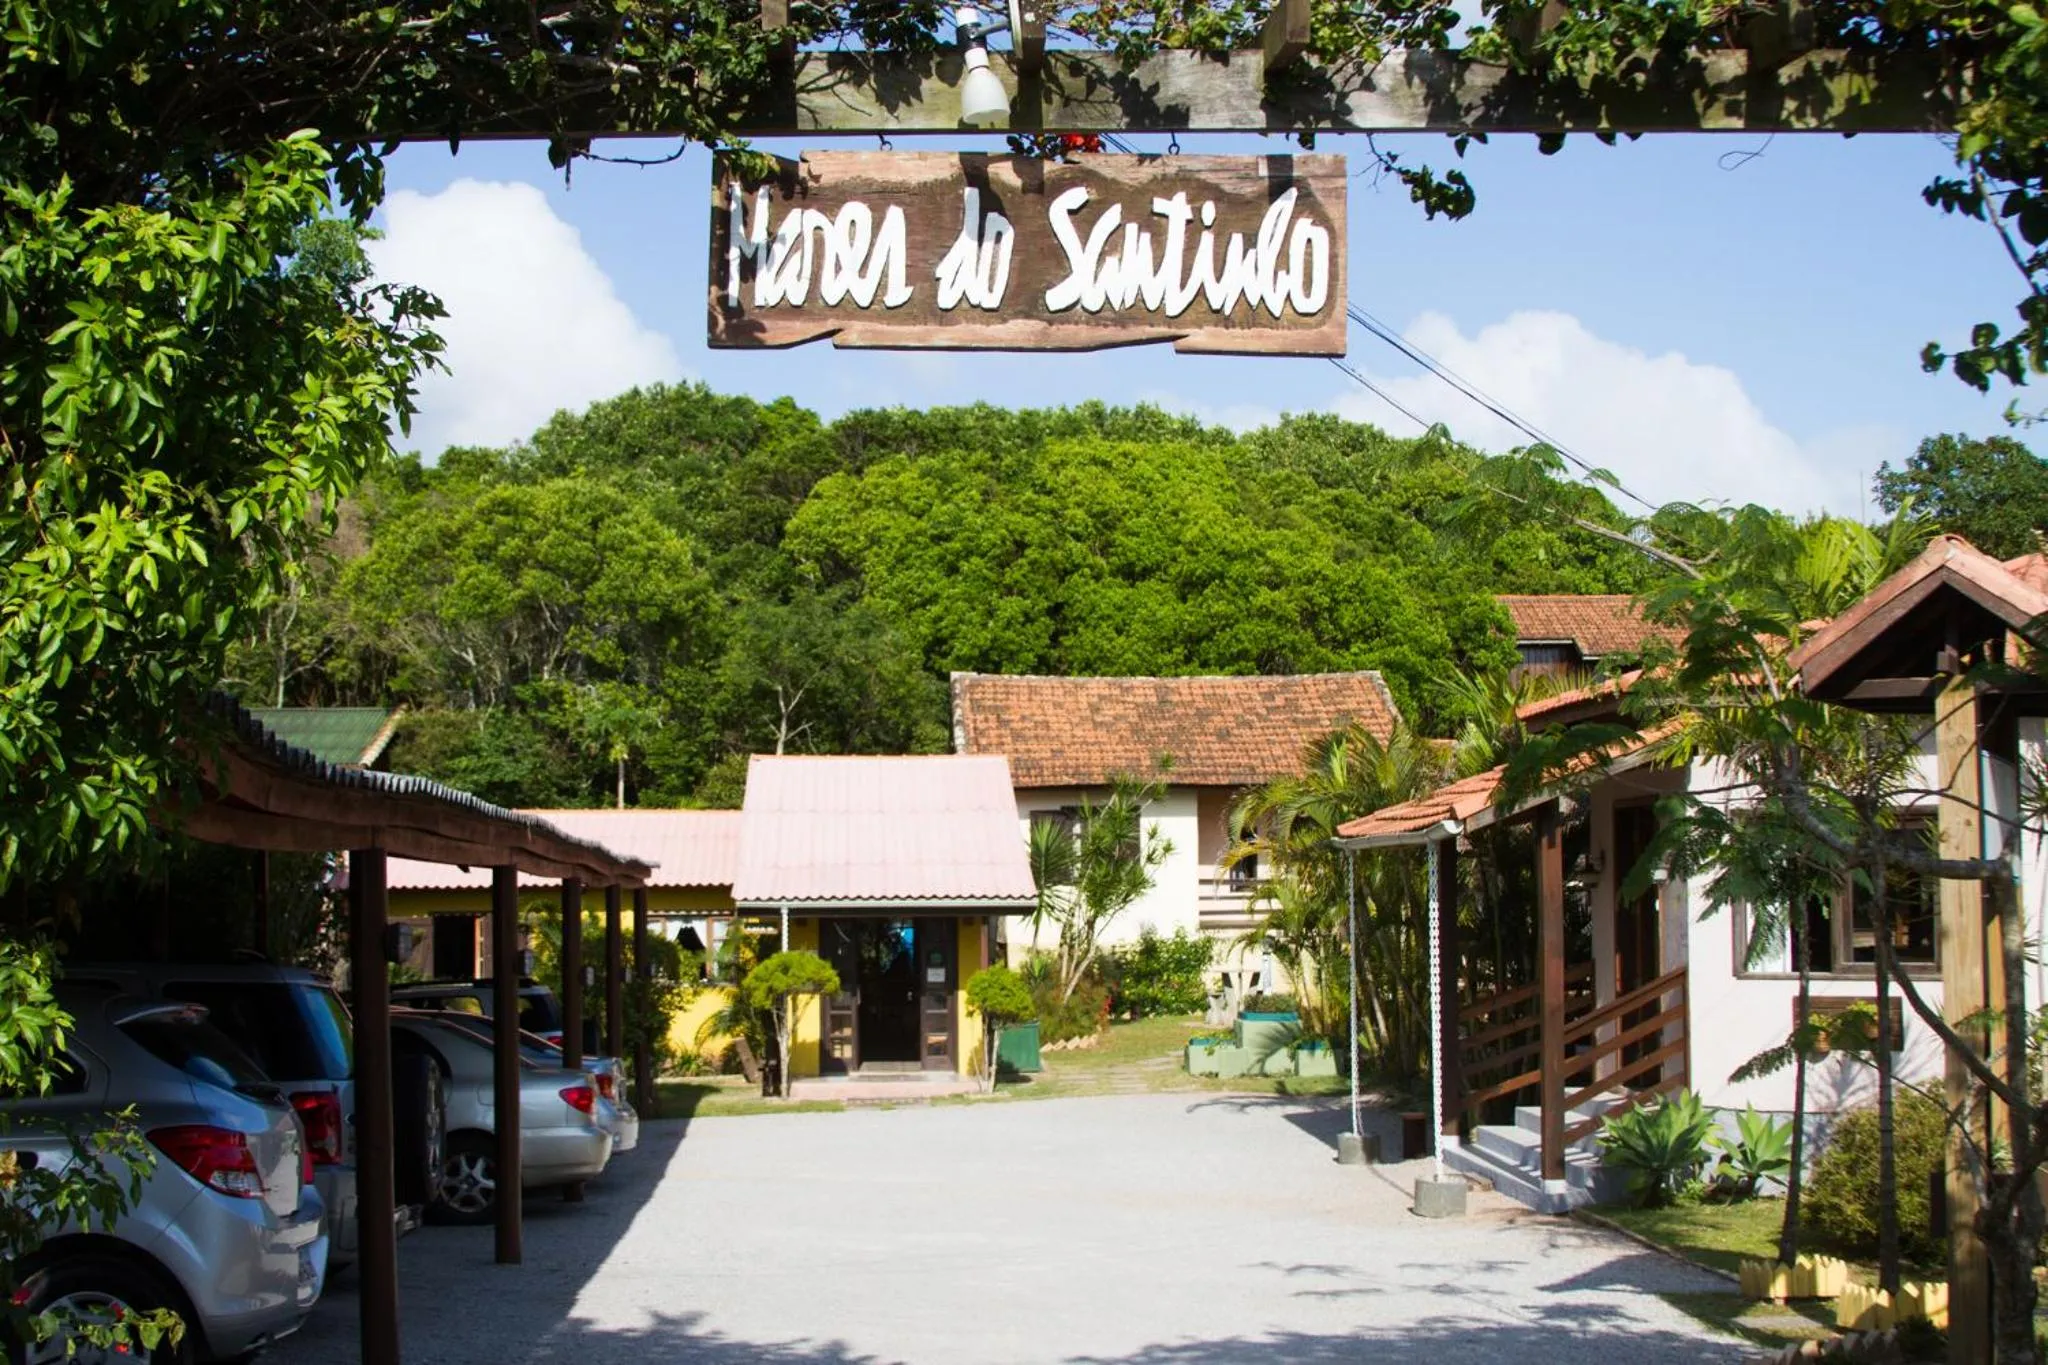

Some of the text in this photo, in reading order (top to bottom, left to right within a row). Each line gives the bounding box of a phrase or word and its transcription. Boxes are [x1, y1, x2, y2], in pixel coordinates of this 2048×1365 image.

[728, 181, 1330, 318] Mares do Santinho
